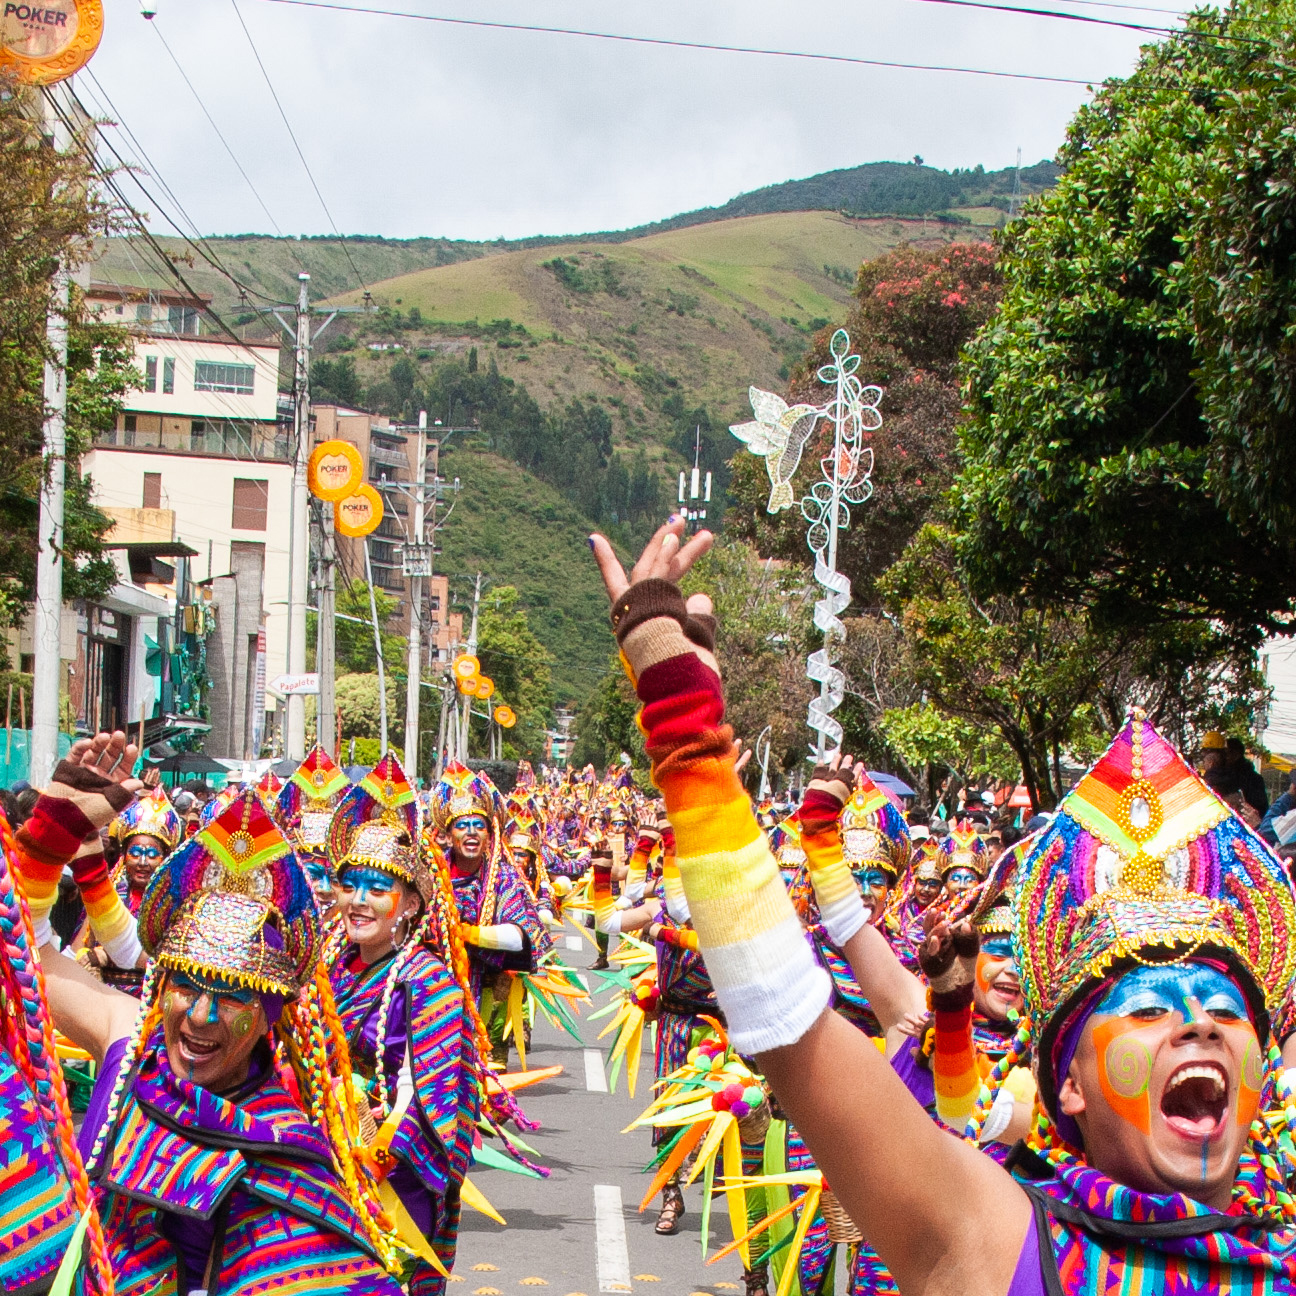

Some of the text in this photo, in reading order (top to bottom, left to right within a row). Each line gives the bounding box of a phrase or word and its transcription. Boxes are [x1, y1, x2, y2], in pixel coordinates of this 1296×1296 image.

[4, 2, 68, 27] POKER
[320, 464, 348, 473] POKER
[343, 503, 369, 512] POKER
